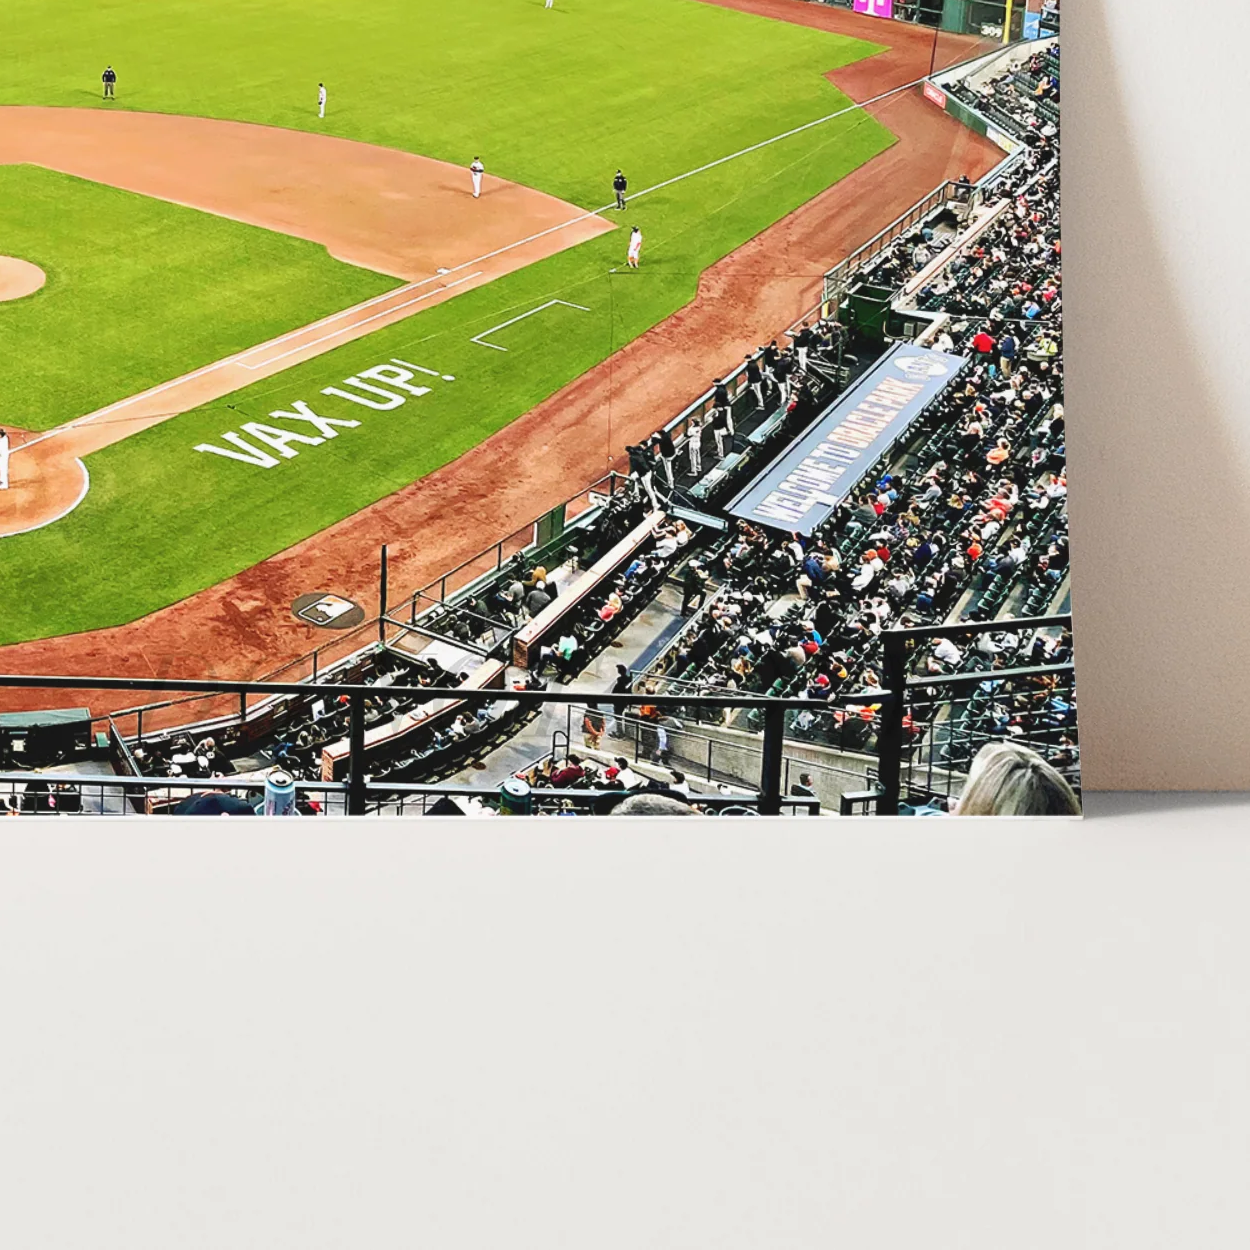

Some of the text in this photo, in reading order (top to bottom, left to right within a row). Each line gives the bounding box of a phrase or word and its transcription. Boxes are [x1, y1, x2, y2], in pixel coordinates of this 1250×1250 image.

[193, 358, 456, 469] VAX UP!
[750, 375, 925, 525] WELCOME TO ORACLE PARK
